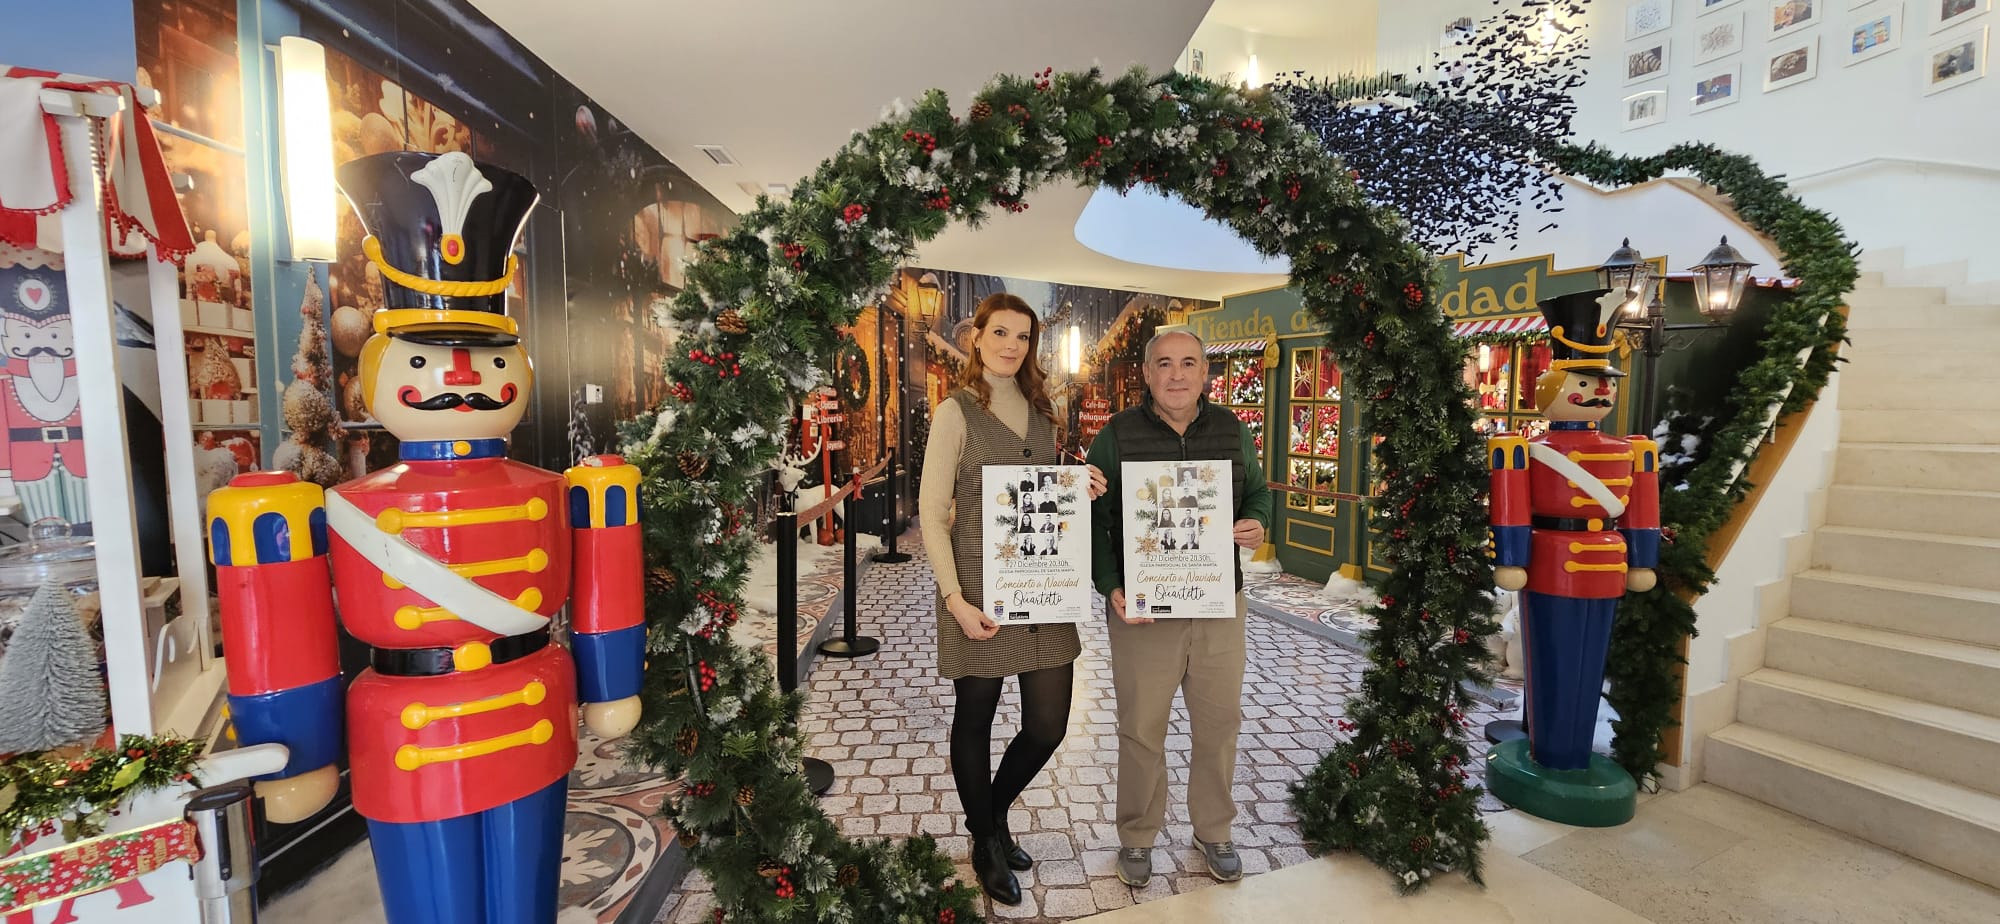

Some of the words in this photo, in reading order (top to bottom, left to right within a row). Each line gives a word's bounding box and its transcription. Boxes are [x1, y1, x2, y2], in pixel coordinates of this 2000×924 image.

[1191, 307, 1277, 341] Tienda
[1017, 559, 1048, 568] Diciembre
[1150, 554, 1157, 562] 27
[1158, 554, 1189, 562] Diciembre
[995, 577, 1036, 590] Concierto
[1043, 577, 1080, 590] Navidad
[1137, 570, 1176, 583] Concierto
[1185, 571, 1222, 584] Navidad
[1013, 590, 1063, 608] Quartetto
[1154, 583, 1206, 602] Quartetto
